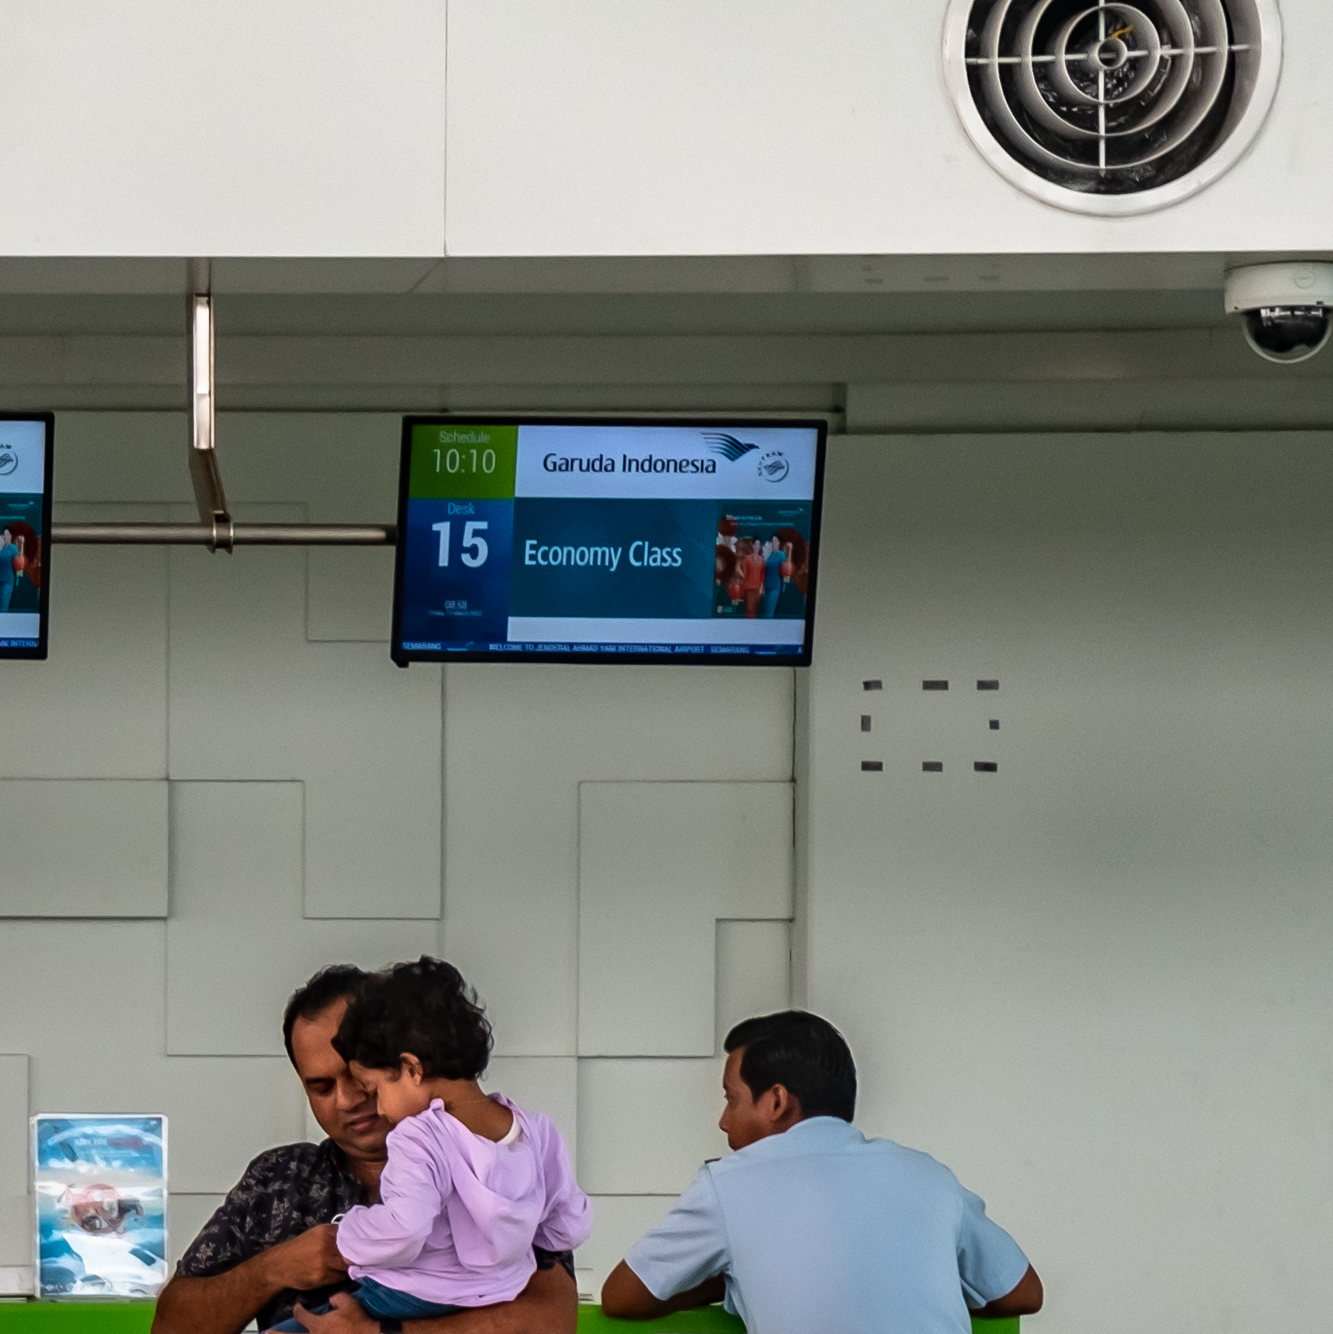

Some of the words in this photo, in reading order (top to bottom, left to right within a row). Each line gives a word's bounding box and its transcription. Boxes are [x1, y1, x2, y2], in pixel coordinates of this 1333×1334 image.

[440, 431, 490, 444] Schedule
[433, 448, 496, 474] 10:10
[543, 453, 615, 474] Garuda
[622, 454, 717, 475] Indonesia
[448, 502, 475, 515] Desk
[432, 521, 489, 568] 15
[525, 539, 626, 571] Economy
[629, 541, 683, 567] Class
